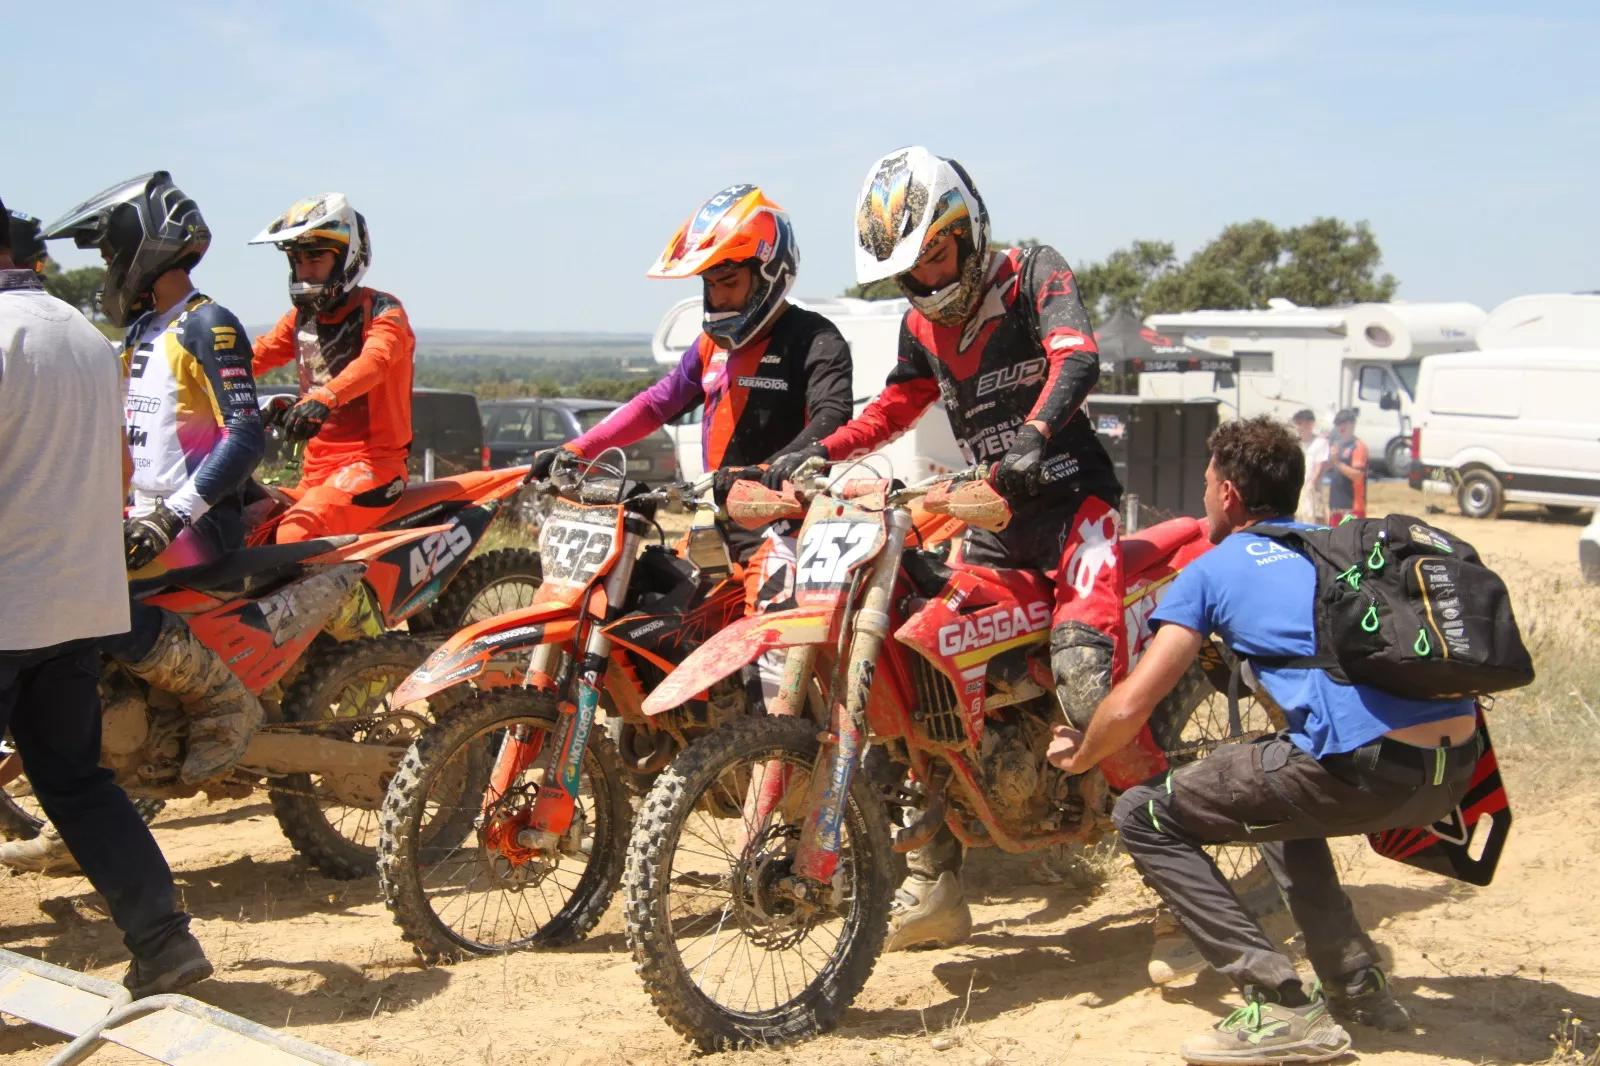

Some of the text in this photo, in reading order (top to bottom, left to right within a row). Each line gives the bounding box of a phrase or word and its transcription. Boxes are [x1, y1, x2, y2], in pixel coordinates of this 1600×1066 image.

[737, 376, 788, 391] DERMOTOR
[997, 421, 1011, 432] DE
[409, 516, 472, 587] 425
[796, 522, 880, 584] 252
[629, 619, 665, 640] DERMOTOR
[938, 601, 1051, 657] GASGAS
[570, 704, 594, 765] MOTOREX
